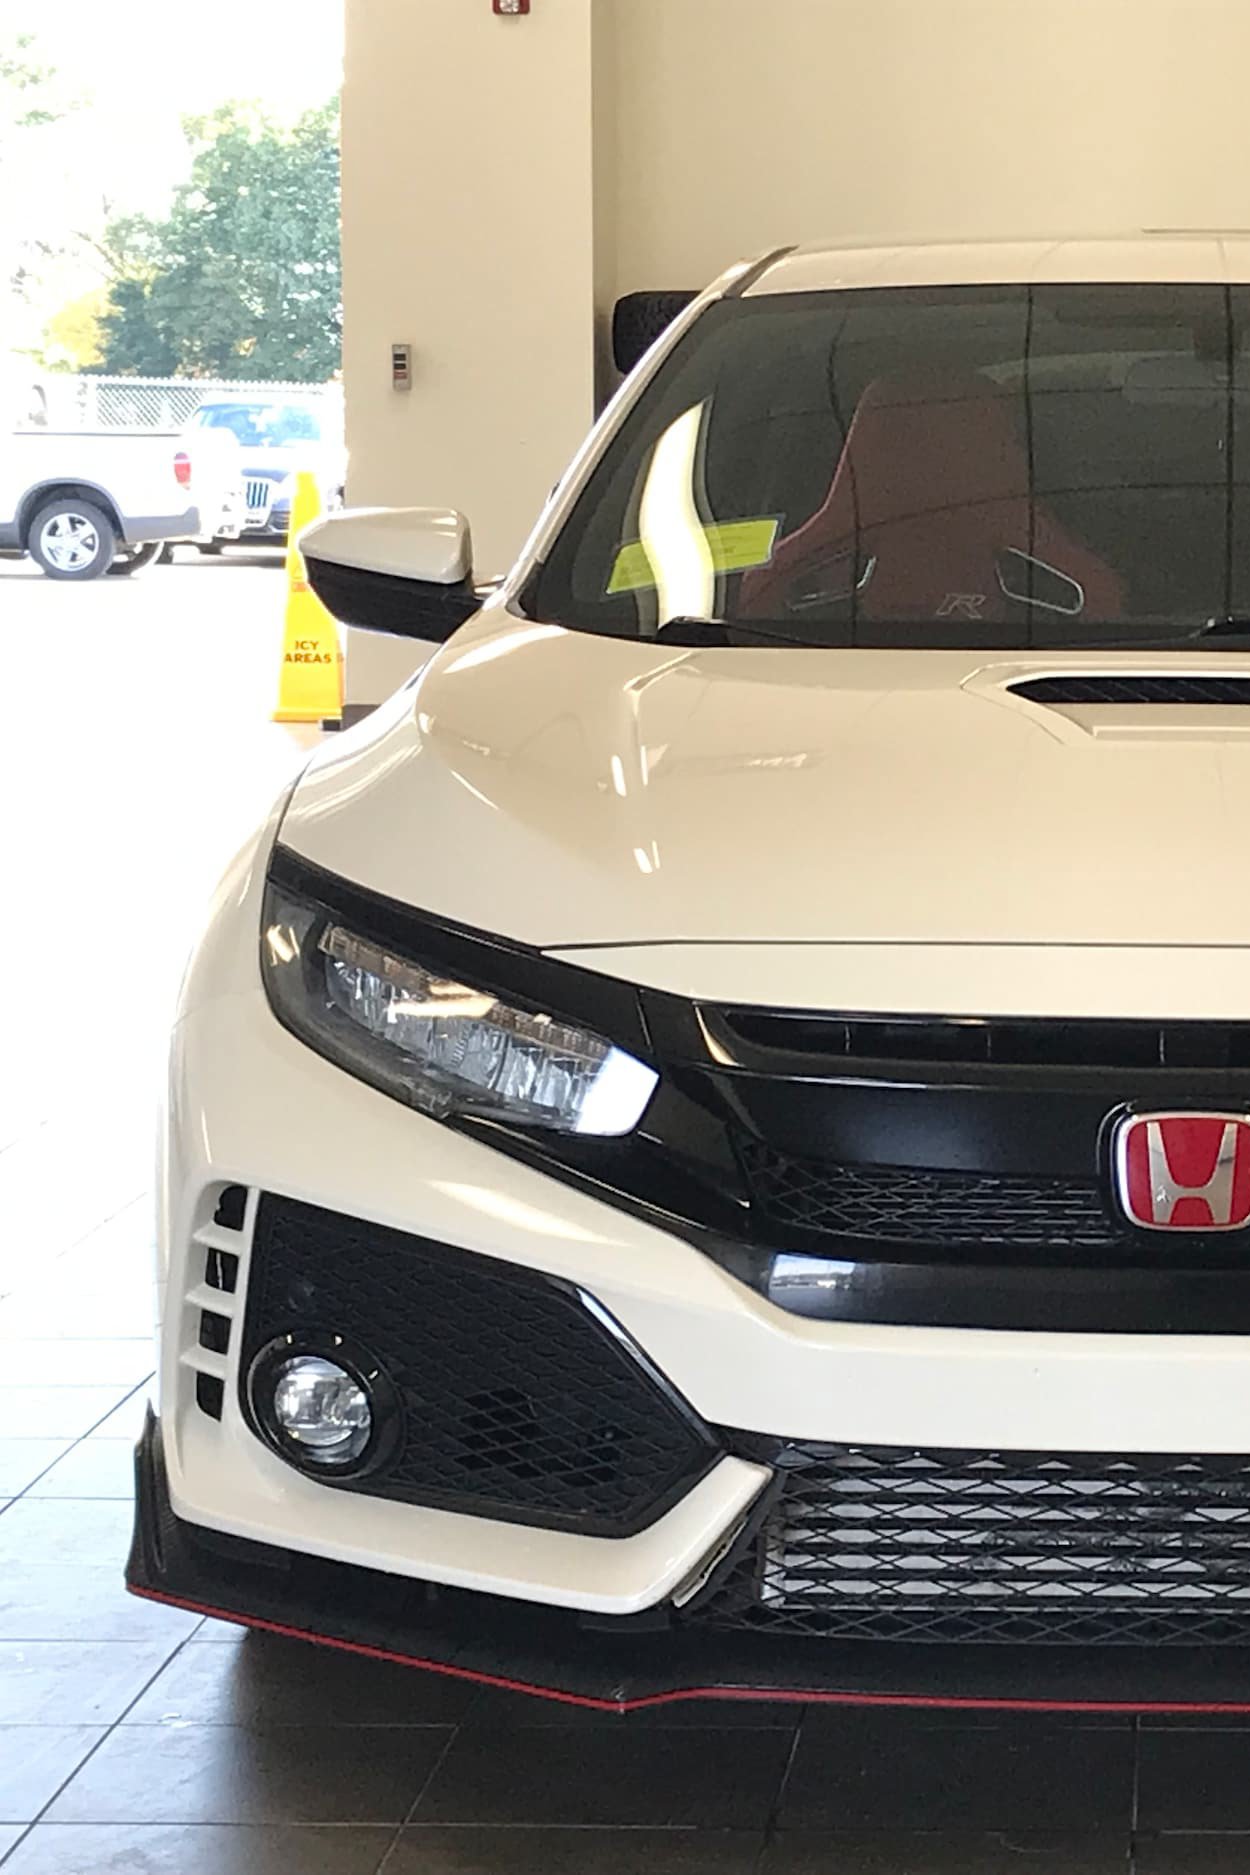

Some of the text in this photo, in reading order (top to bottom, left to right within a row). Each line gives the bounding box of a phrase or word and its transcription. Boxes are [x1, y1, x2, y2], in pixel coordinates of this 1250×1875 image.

[935, 593, 986, 619] R
[295, 640, 319, 651] ICY
[284, 653, 332, 664] AREAS
